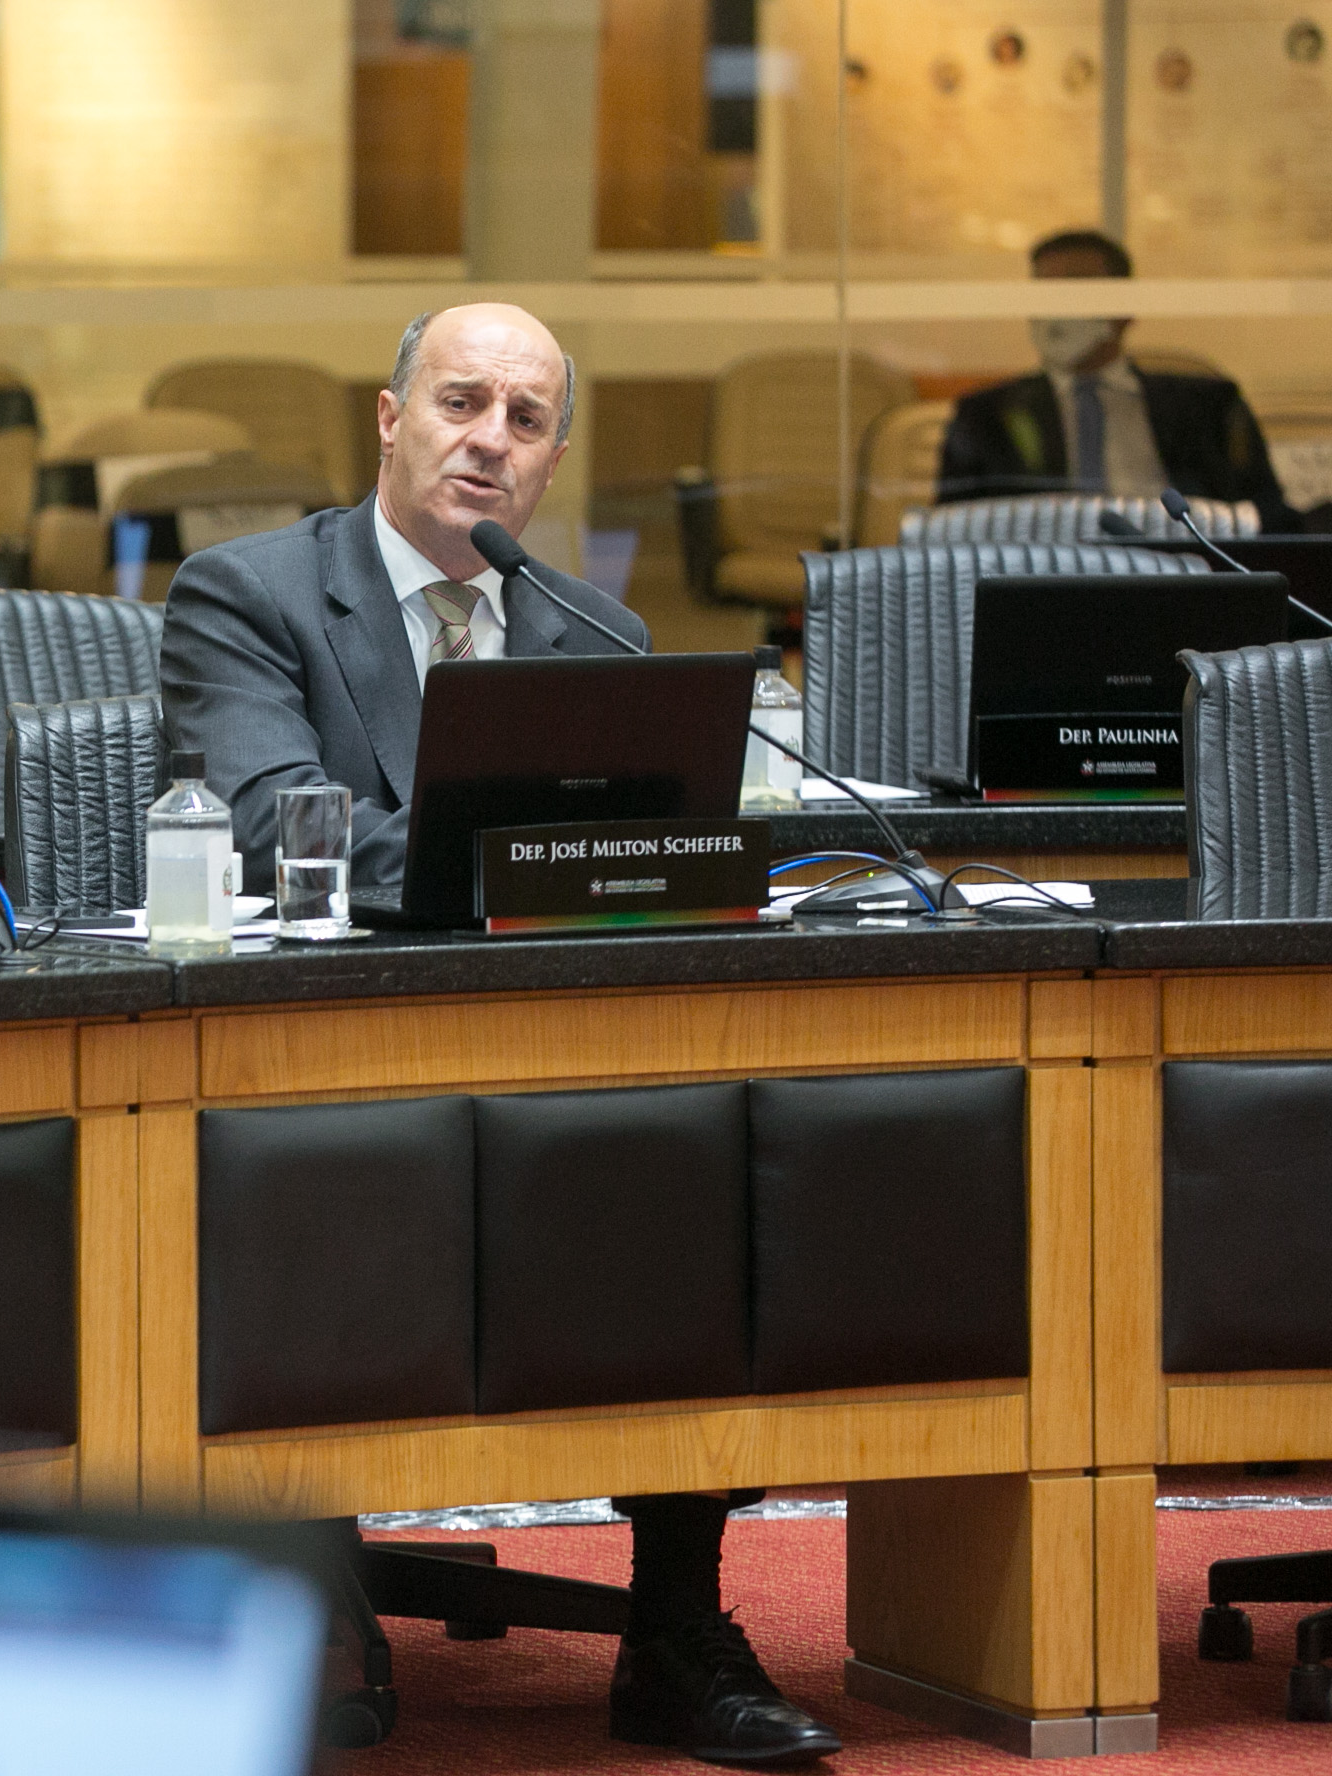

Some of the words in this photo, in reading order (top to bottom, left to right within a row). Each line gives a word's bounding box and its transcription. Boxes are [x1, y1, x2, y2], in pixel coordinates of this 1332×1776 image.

[1098, 727, 1179, 744] PAULINHA
[510, 842, 545, 861] DEP.
[550, 838, 587, 864] JOSÉ
[592, 839, 658, 858] MILTON
[663, 835, 744, 855] SCHEFFER
